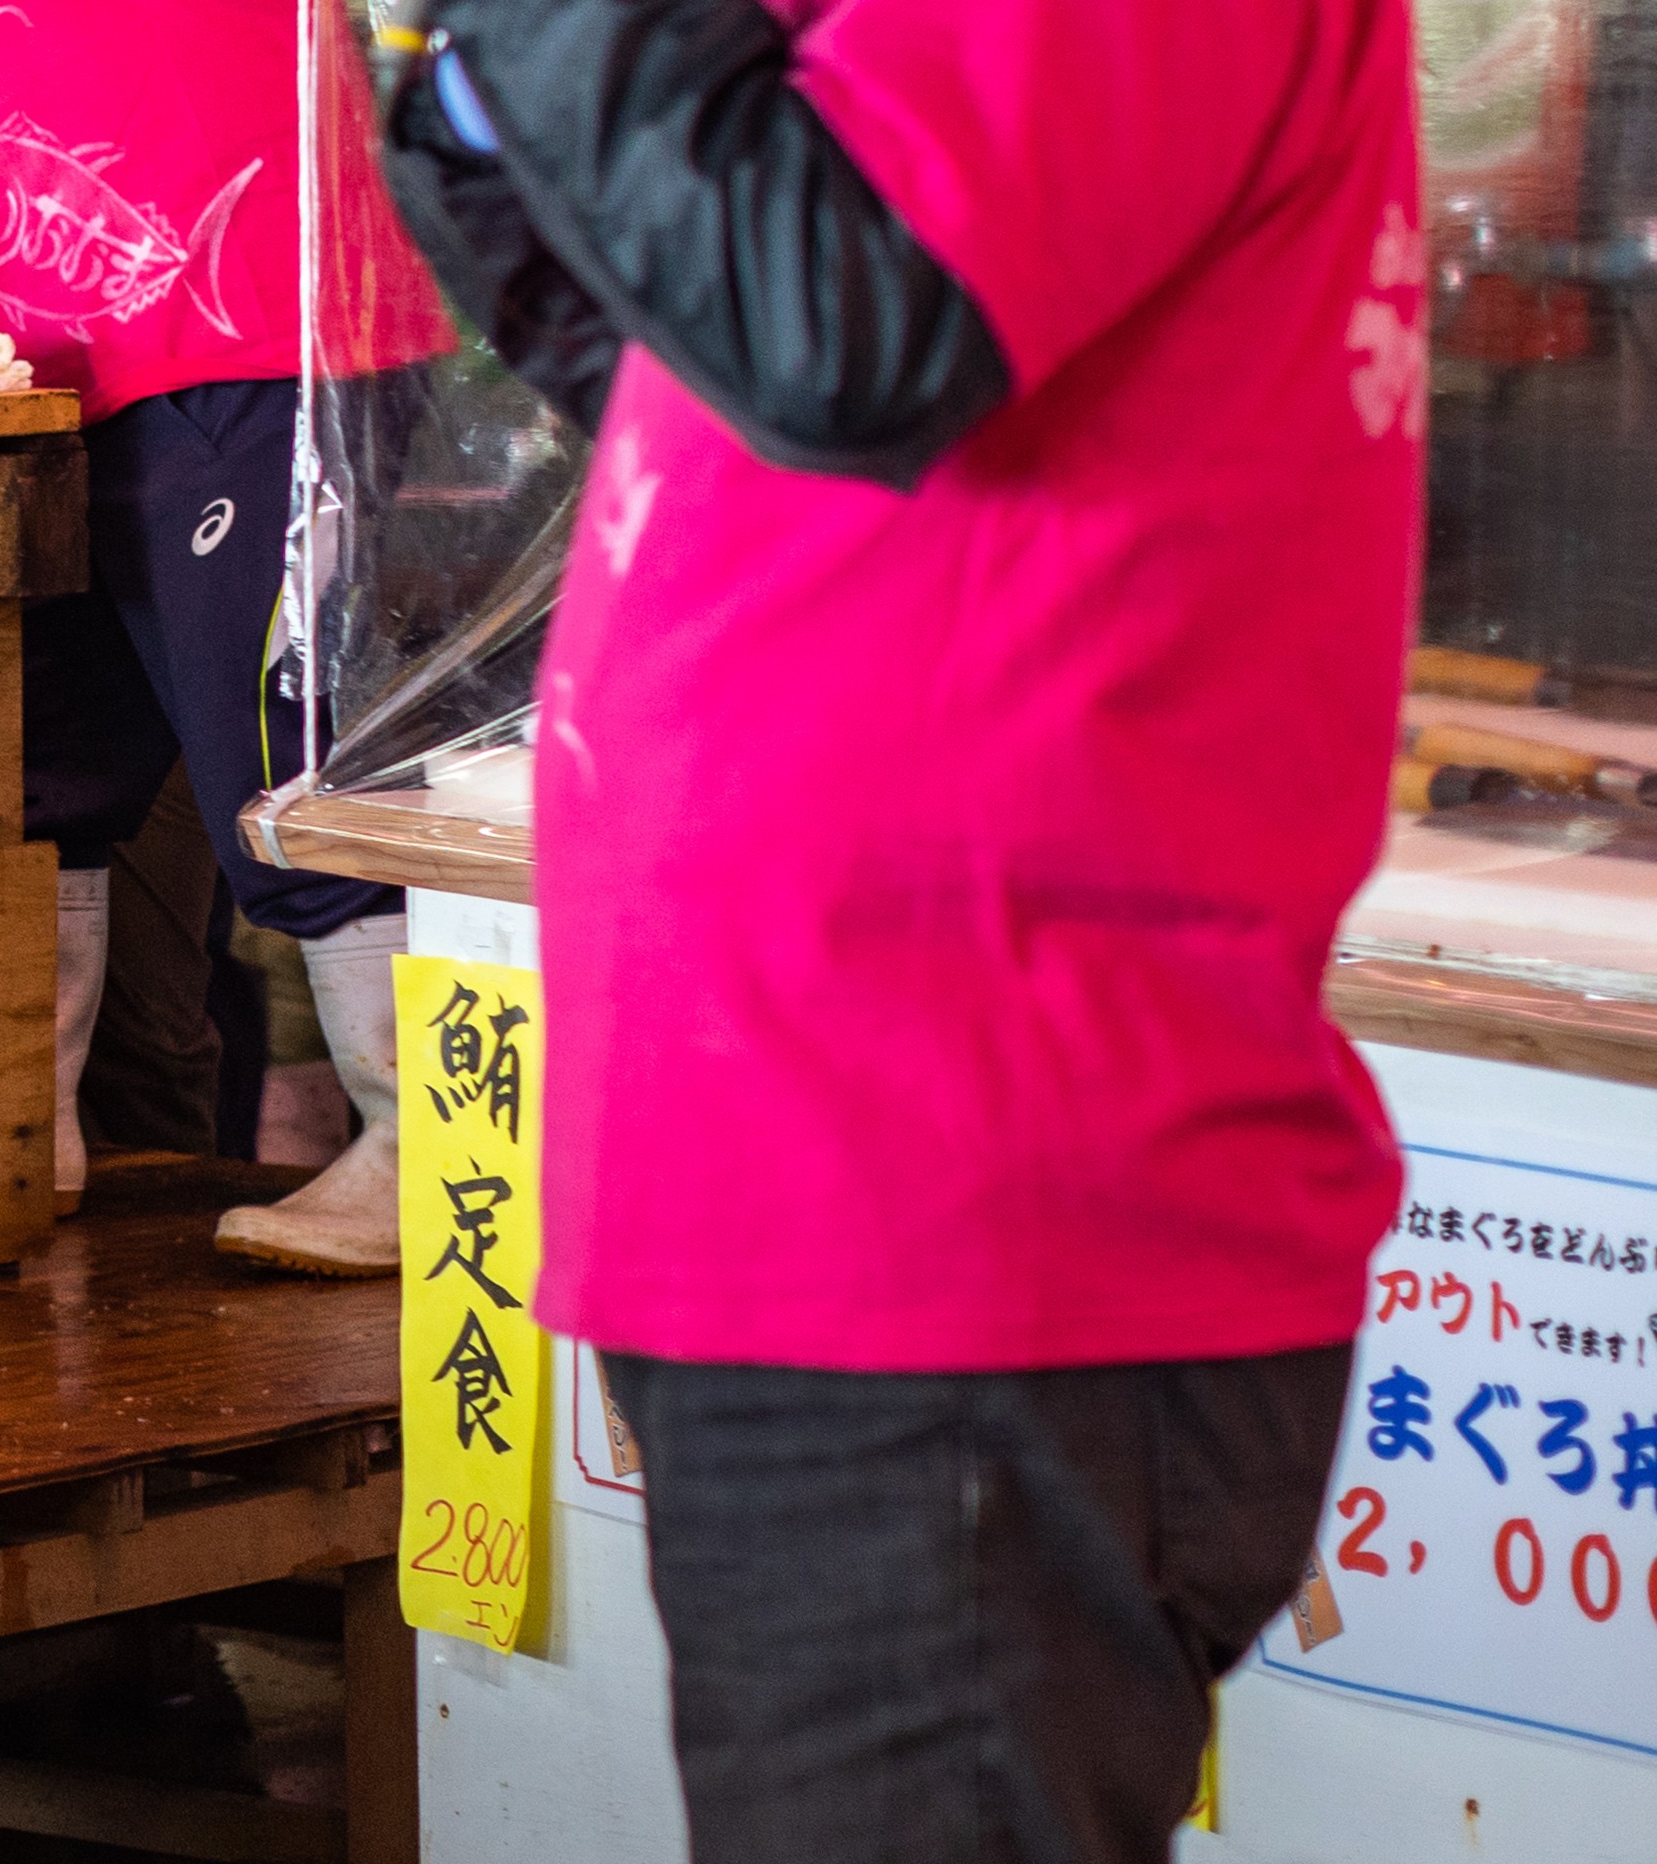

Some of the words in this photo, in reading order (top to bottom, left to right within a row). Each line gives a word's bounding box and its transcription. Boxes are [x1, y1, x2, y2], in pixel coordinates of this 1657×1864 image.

[423, 979, 529, 1454] 鮪定食
[1389, 1198, 1657, 1276] なまぐろをどんぶ
[1336, 1485, 1657, 1626] 2,00
